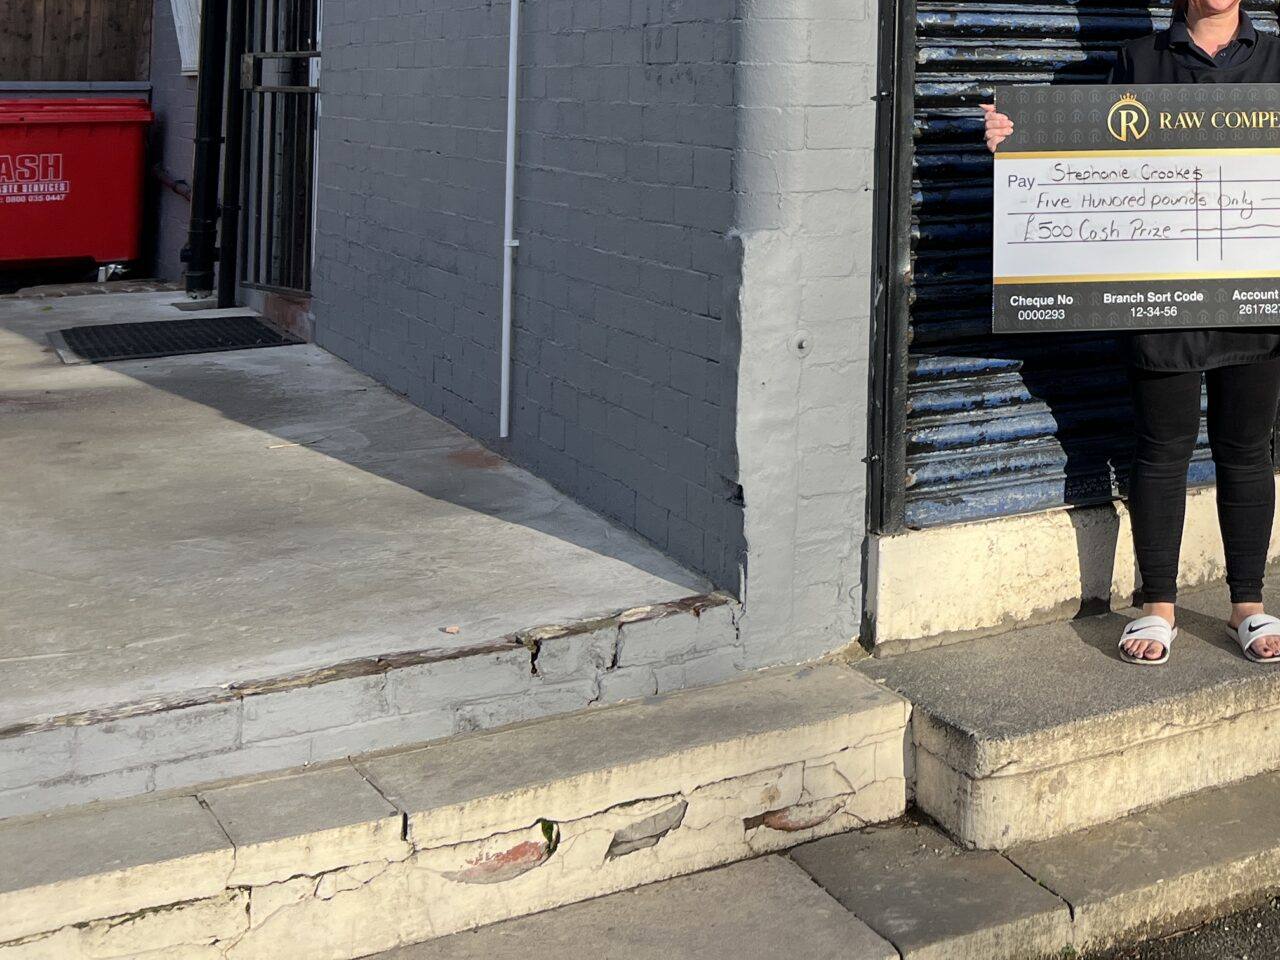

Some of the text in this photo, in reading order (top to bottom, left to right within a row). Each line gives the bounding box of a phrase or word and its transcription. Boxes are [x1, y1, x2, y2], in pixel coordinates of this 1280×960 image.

[1159, 111, 1204, 129] RAW
[1008, 175, 1035, 190] Pay
[1024, 213, 1172, 241] £500 Cash Prize
[1010, 294, 1074, 308] Cheque No
[1103, 291, 1204, 303] Branch Sort Code
[1232, 289, 1279, 300] Account
[1018, 309, 1066, 320] 0000293
[1131, 306, 1178, 317] 12-34-56
